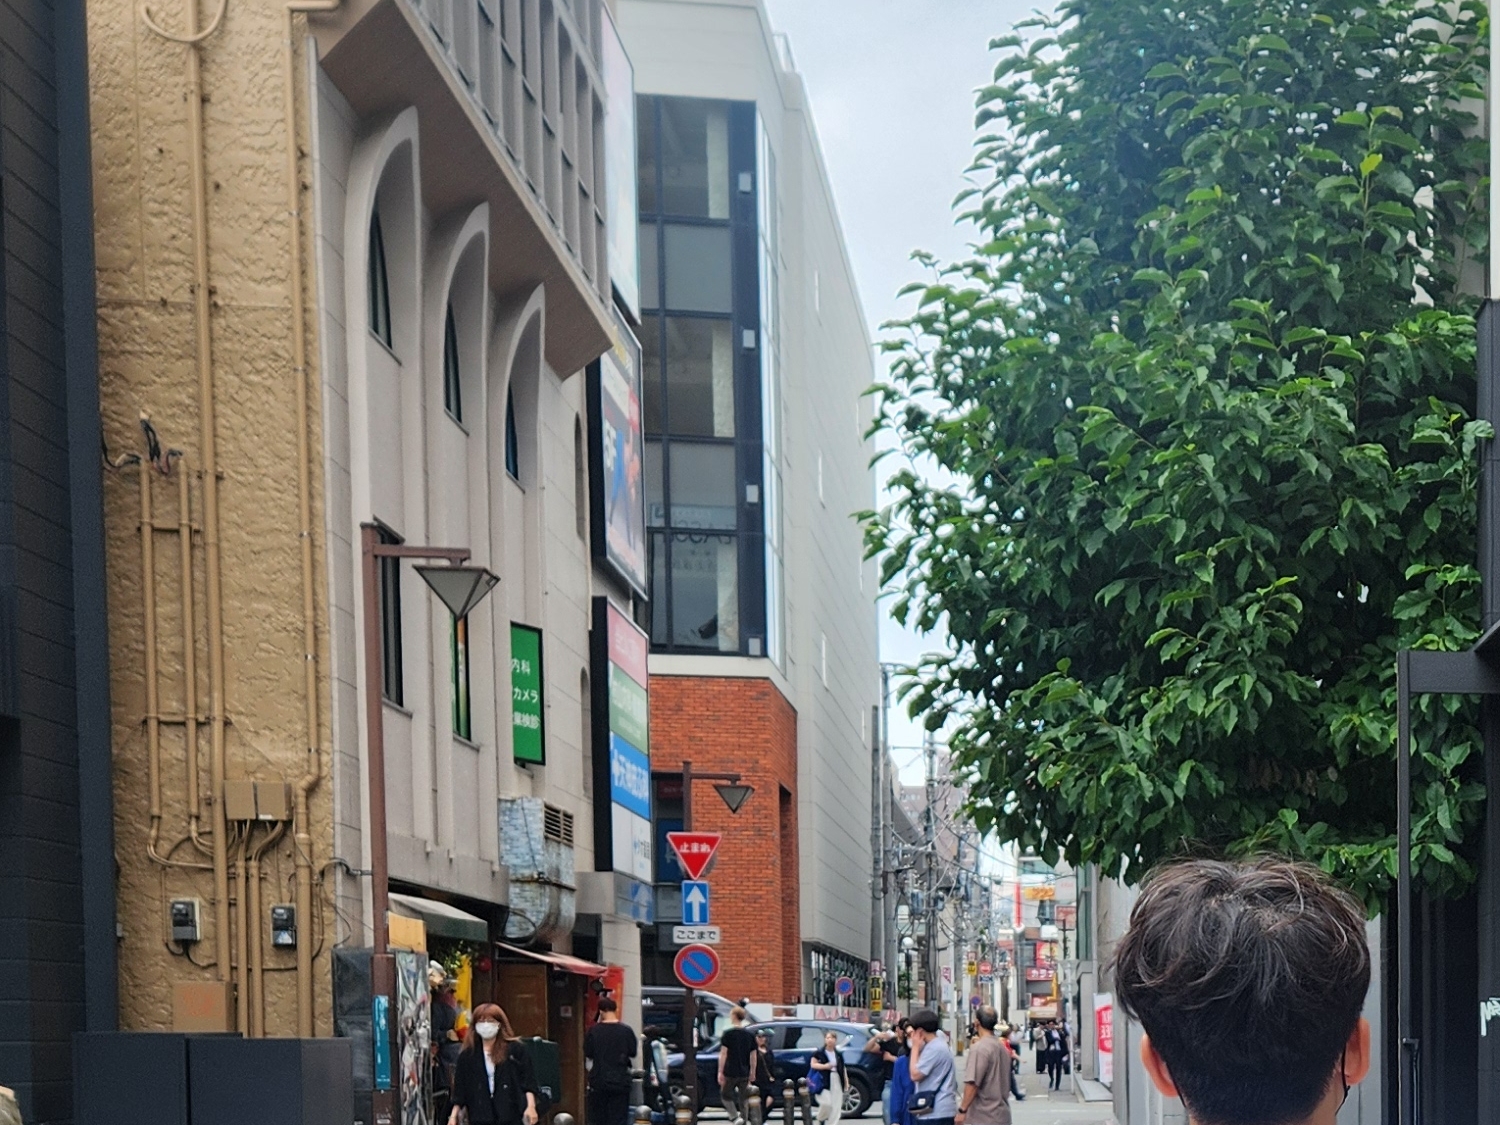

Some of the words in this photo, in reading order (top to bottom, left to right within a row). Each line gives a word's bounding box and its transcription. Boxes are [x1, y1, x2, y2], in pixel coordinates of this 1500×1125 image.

[511, 686, 539, 703] カメラ
[679, 841, 711, 853] 止まれ
[676, 929, 717, 940] ここまで
